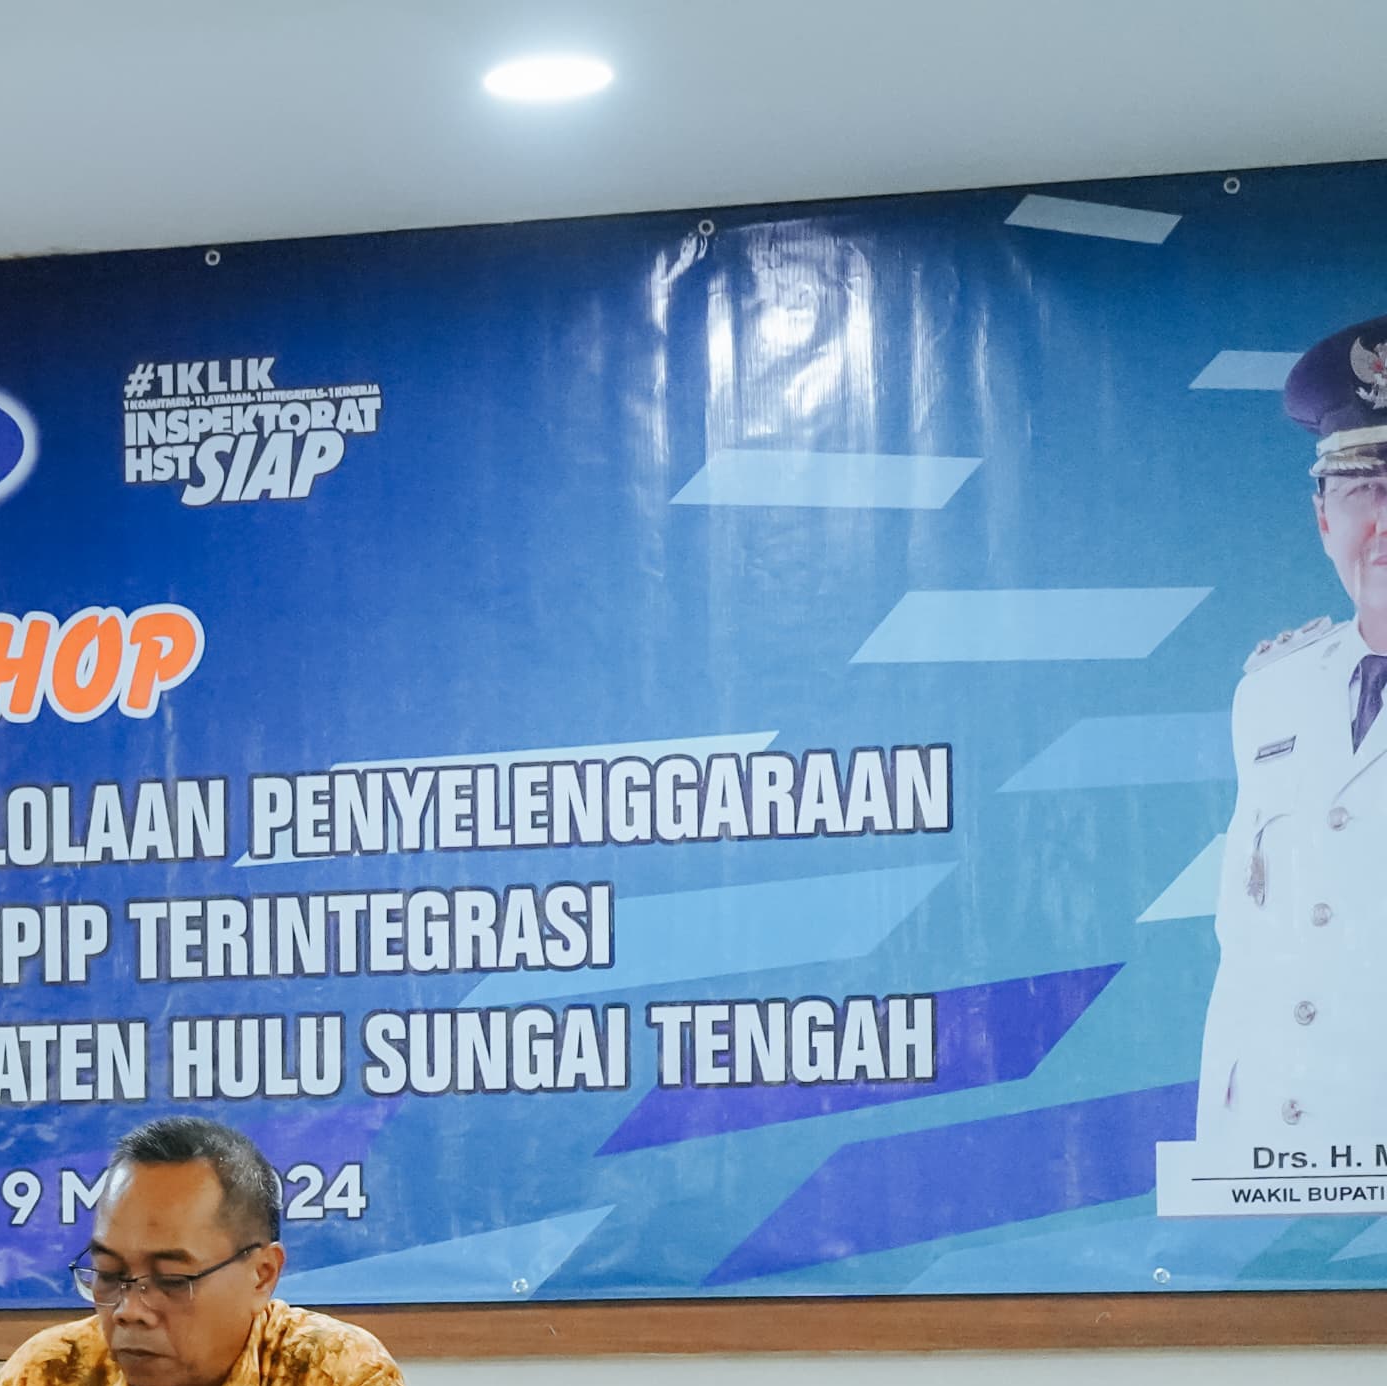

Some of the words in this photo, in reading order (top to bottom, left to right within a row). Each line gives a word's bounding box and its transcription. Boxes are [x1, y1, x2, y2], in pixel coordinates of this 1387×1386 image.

[124, 357, 275, 398] #1KLIK
[125, 397, 381, 446] INSPEKTORAT
[125, 446, 195, 483] HST
[181, 429, 344, 506] SIAP
[253, 748, 950, 857] PENYELENGGARAAN
[129, 884, 611, 981] TERINTEGRASI
[172, 1014, 342, 1098] HULU
[363, 1006, 627, 1094] SUNGAI
[650, 998, 935, 1086] TENGAH
[1253, 1146, 1317, 1169] Drs.
[1331, 1145, 1362, 1168] H.
[1, 1170, 42, 1225] 9
[271, 1164, 367, 1220] 24
[1231, 1187, 1301, 1203] WAKIL
[1308, 1186, 1385, 1201] BUPATI
